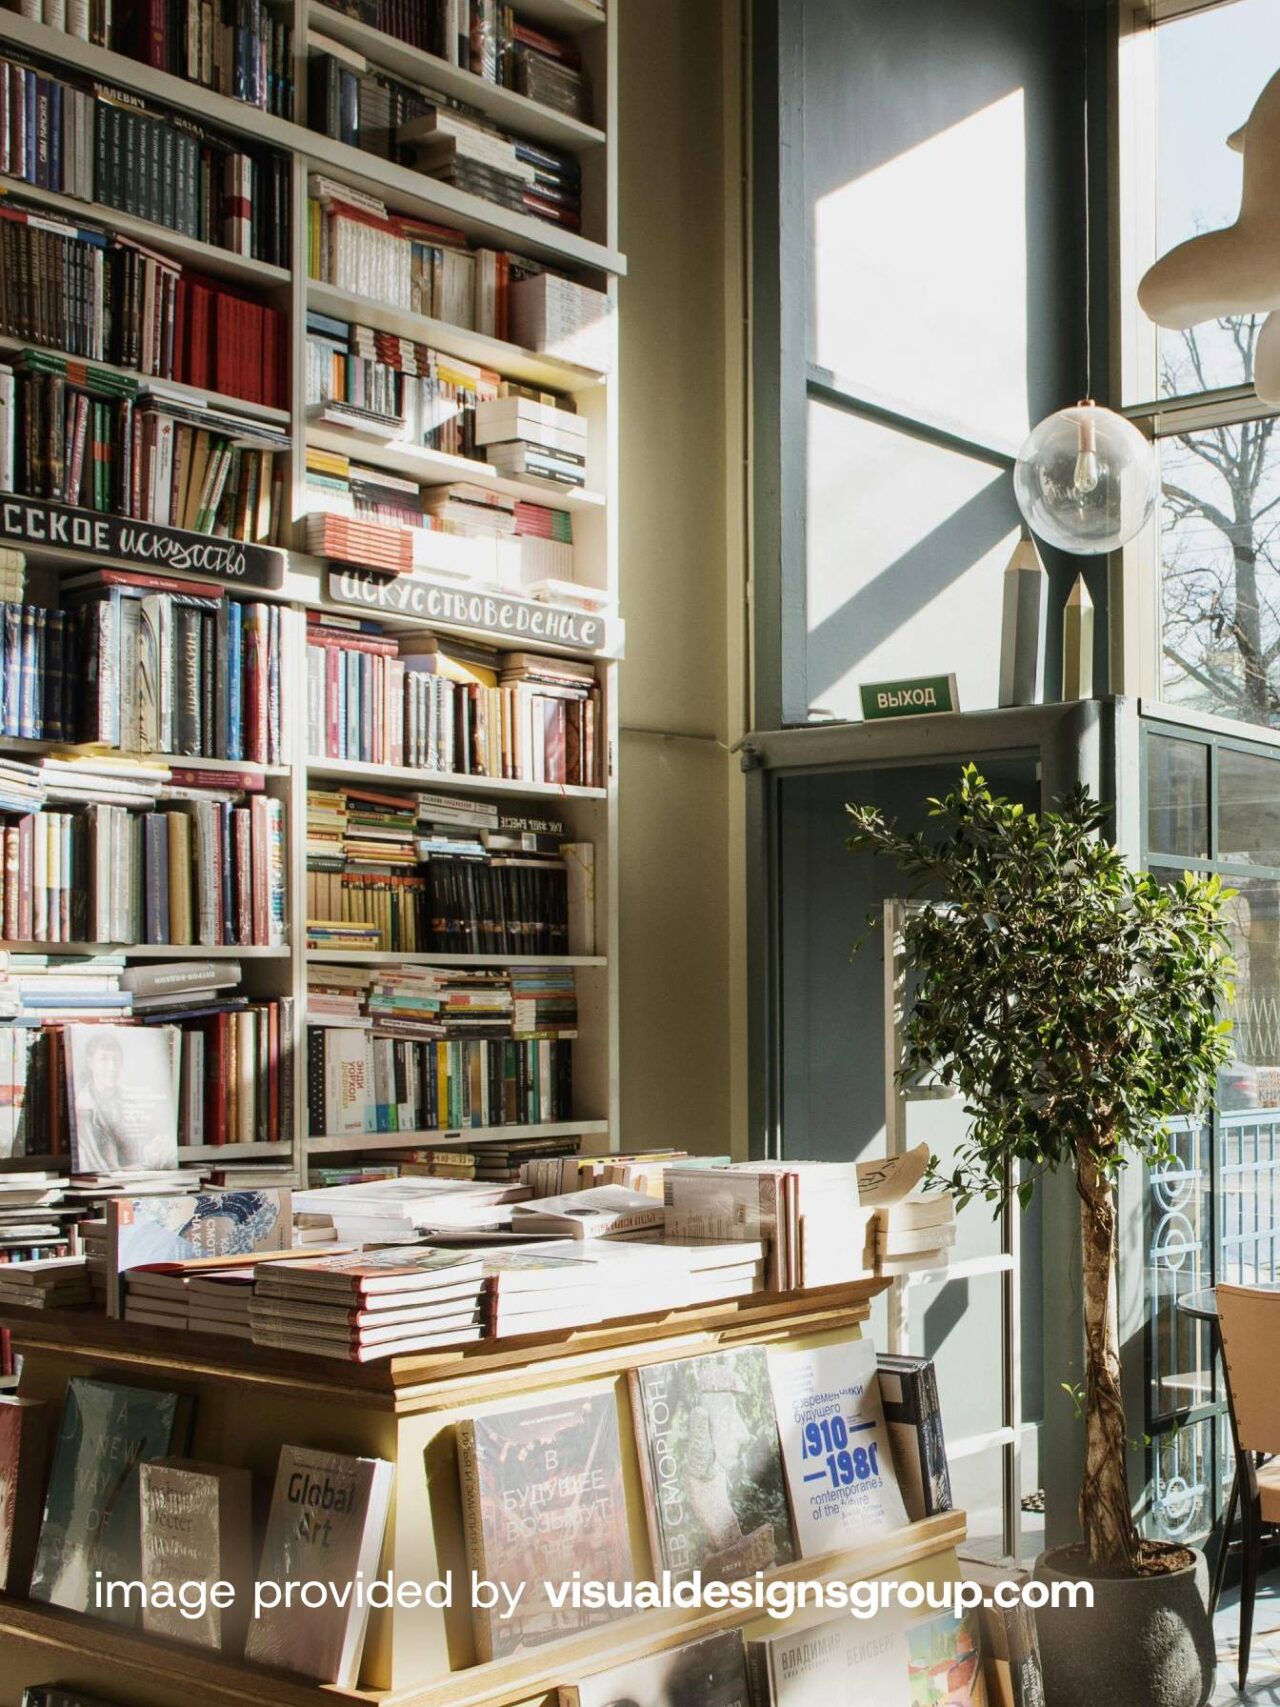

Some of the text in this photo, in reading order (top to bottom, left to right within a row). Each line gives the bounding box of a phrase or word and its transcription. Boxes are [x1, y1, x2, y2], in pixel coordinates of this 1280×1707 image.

[94, 82, 145, 109] МАЛЕВИЧ
[119, 527, 247, 577] искусство
[340, 571, 597, 645] искусствоведение
[186, 631, 198, 716] ШЕМЯКИН
[877, 688, 937, 709] ВЫХОД
[206, 1219, 216, 1258] СМОТ
[117, 1402, 129, 1425] A
[96, 1434, 142, 1464] NEW
[545, 1450, 559, 1471] В
[288, 1472, 356, 1514] Global
[503, 1469, 605, 1512] БУДУЩЕЕ
[87, 1509, 112, 1532] OF
[824, 1501, 841, 1518] the
[295, 1513, 333, 1548] Art
[782, 1632, 841, 1672] ВЛАДИМИР
